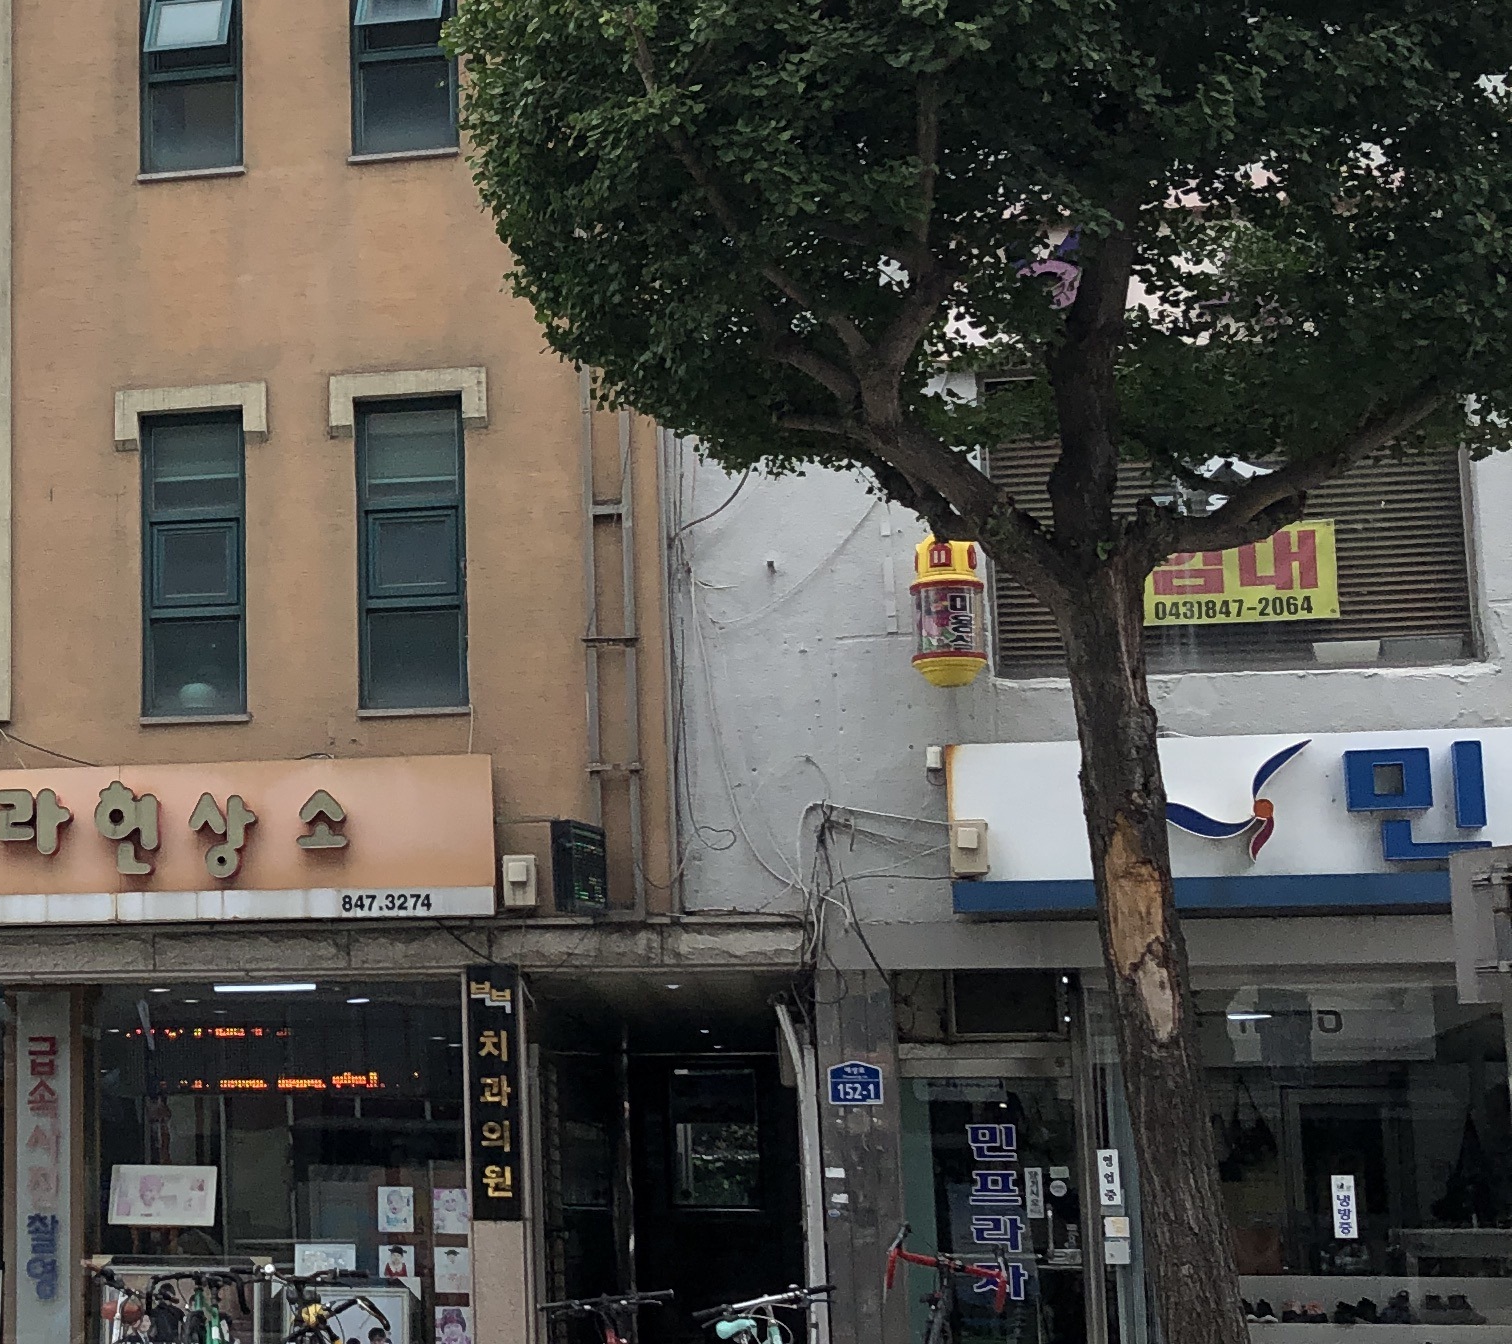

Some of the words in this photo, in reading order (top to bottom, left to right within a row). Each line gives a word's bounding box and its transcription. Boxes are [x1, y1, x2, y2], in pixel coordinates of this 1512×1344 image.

[341, 892, 433, 913] 847.3274
[478, 1029, 513, 1198] 치과의원
[837, 1083, 875, 1099] 152-1
[965, 1123, 1029, 1301] 민프라자
